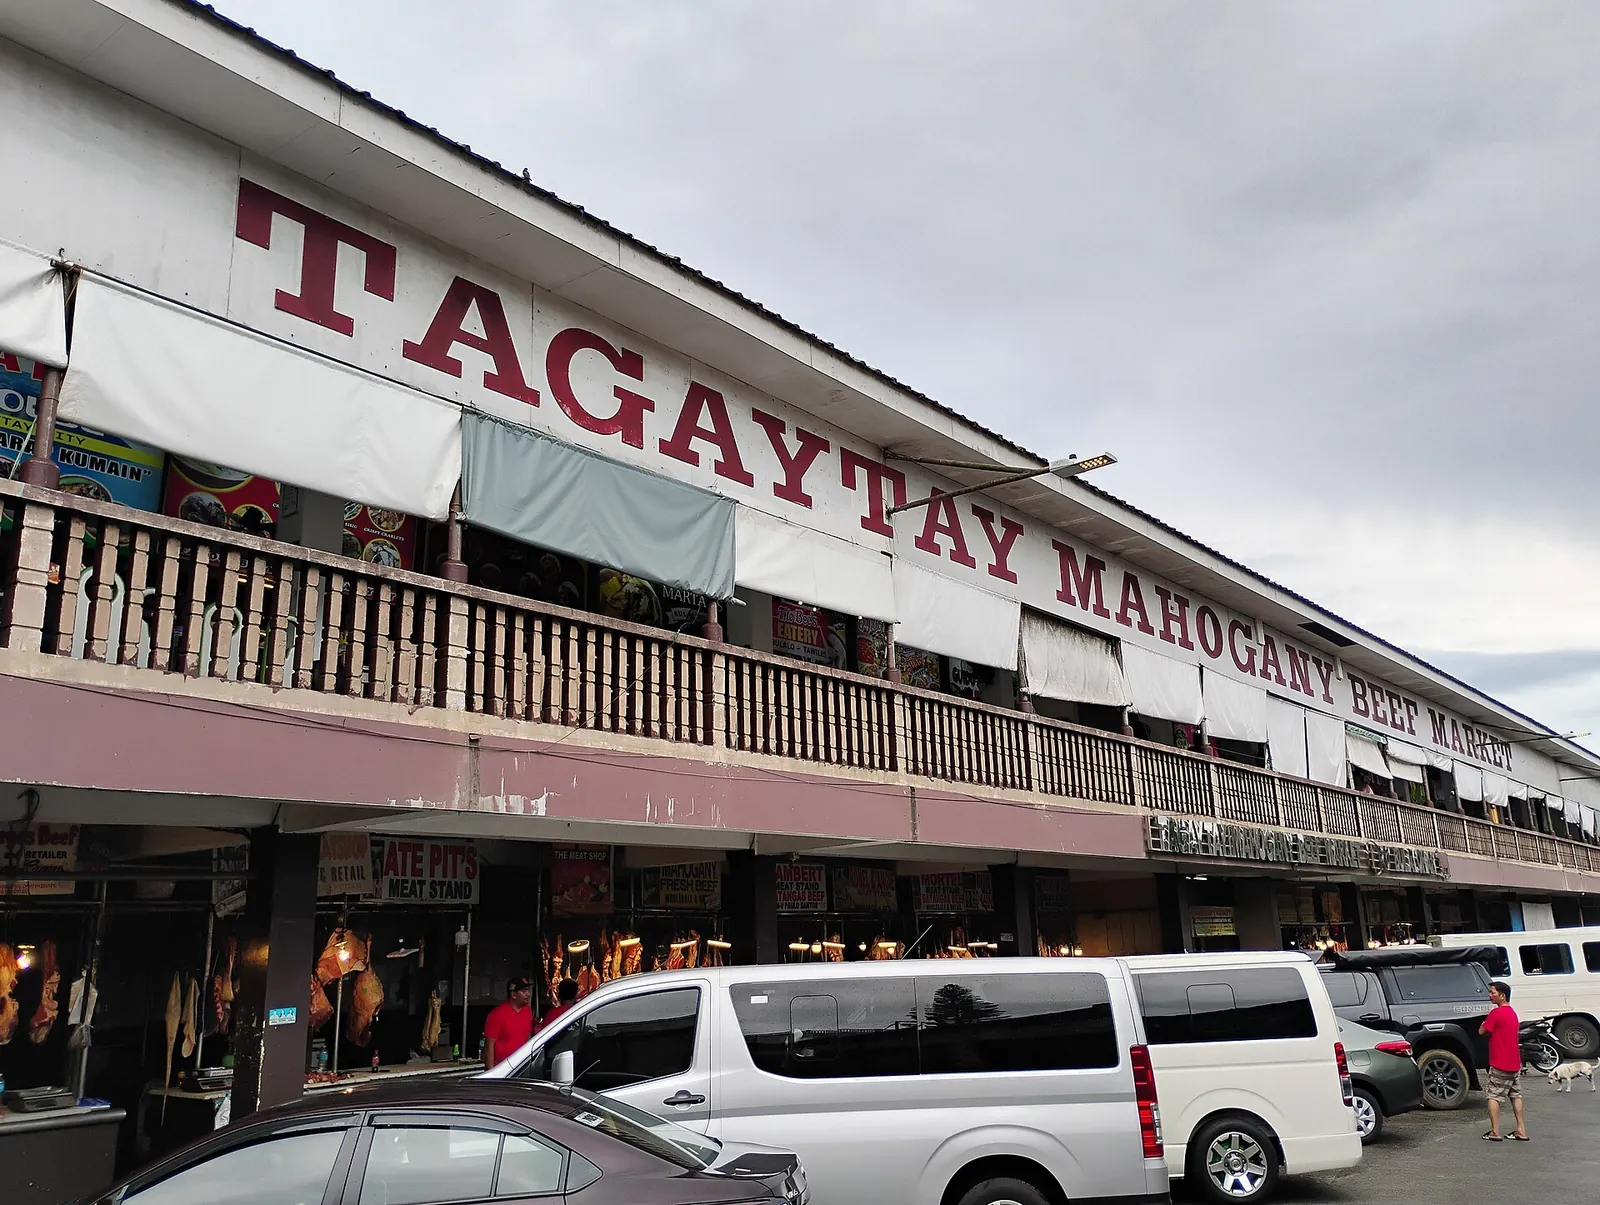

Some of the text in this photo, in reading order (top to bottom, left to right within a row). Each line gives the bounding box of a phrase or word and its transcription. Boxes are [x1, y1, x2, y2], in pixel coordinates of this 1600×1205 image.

[235, 177, 1024, 585] TAGAYTAY
[1051, 538, 1334, 705] MAHOGANY
[1346, 672, 1419, 737] BEEF
[1427, 707, 1513, 773] MARKET
[777, 621, 819, 645] EATERY
[25, 850, 67, 859] RETAILER
[383, 841, 424, 878] ATE
[429, 843, 478, 880] PIT'S
[554, 850, 607, 861] THE MEAT SHOP
[331, 865, 367, 882] RETAIL
[388, 878, 473, 900] MEAT STAND
[660, 878, 719, 892] FRESH BEEF
[795, 881, 820, 890] STAND
[807, 890, 825, 901] BEEF
